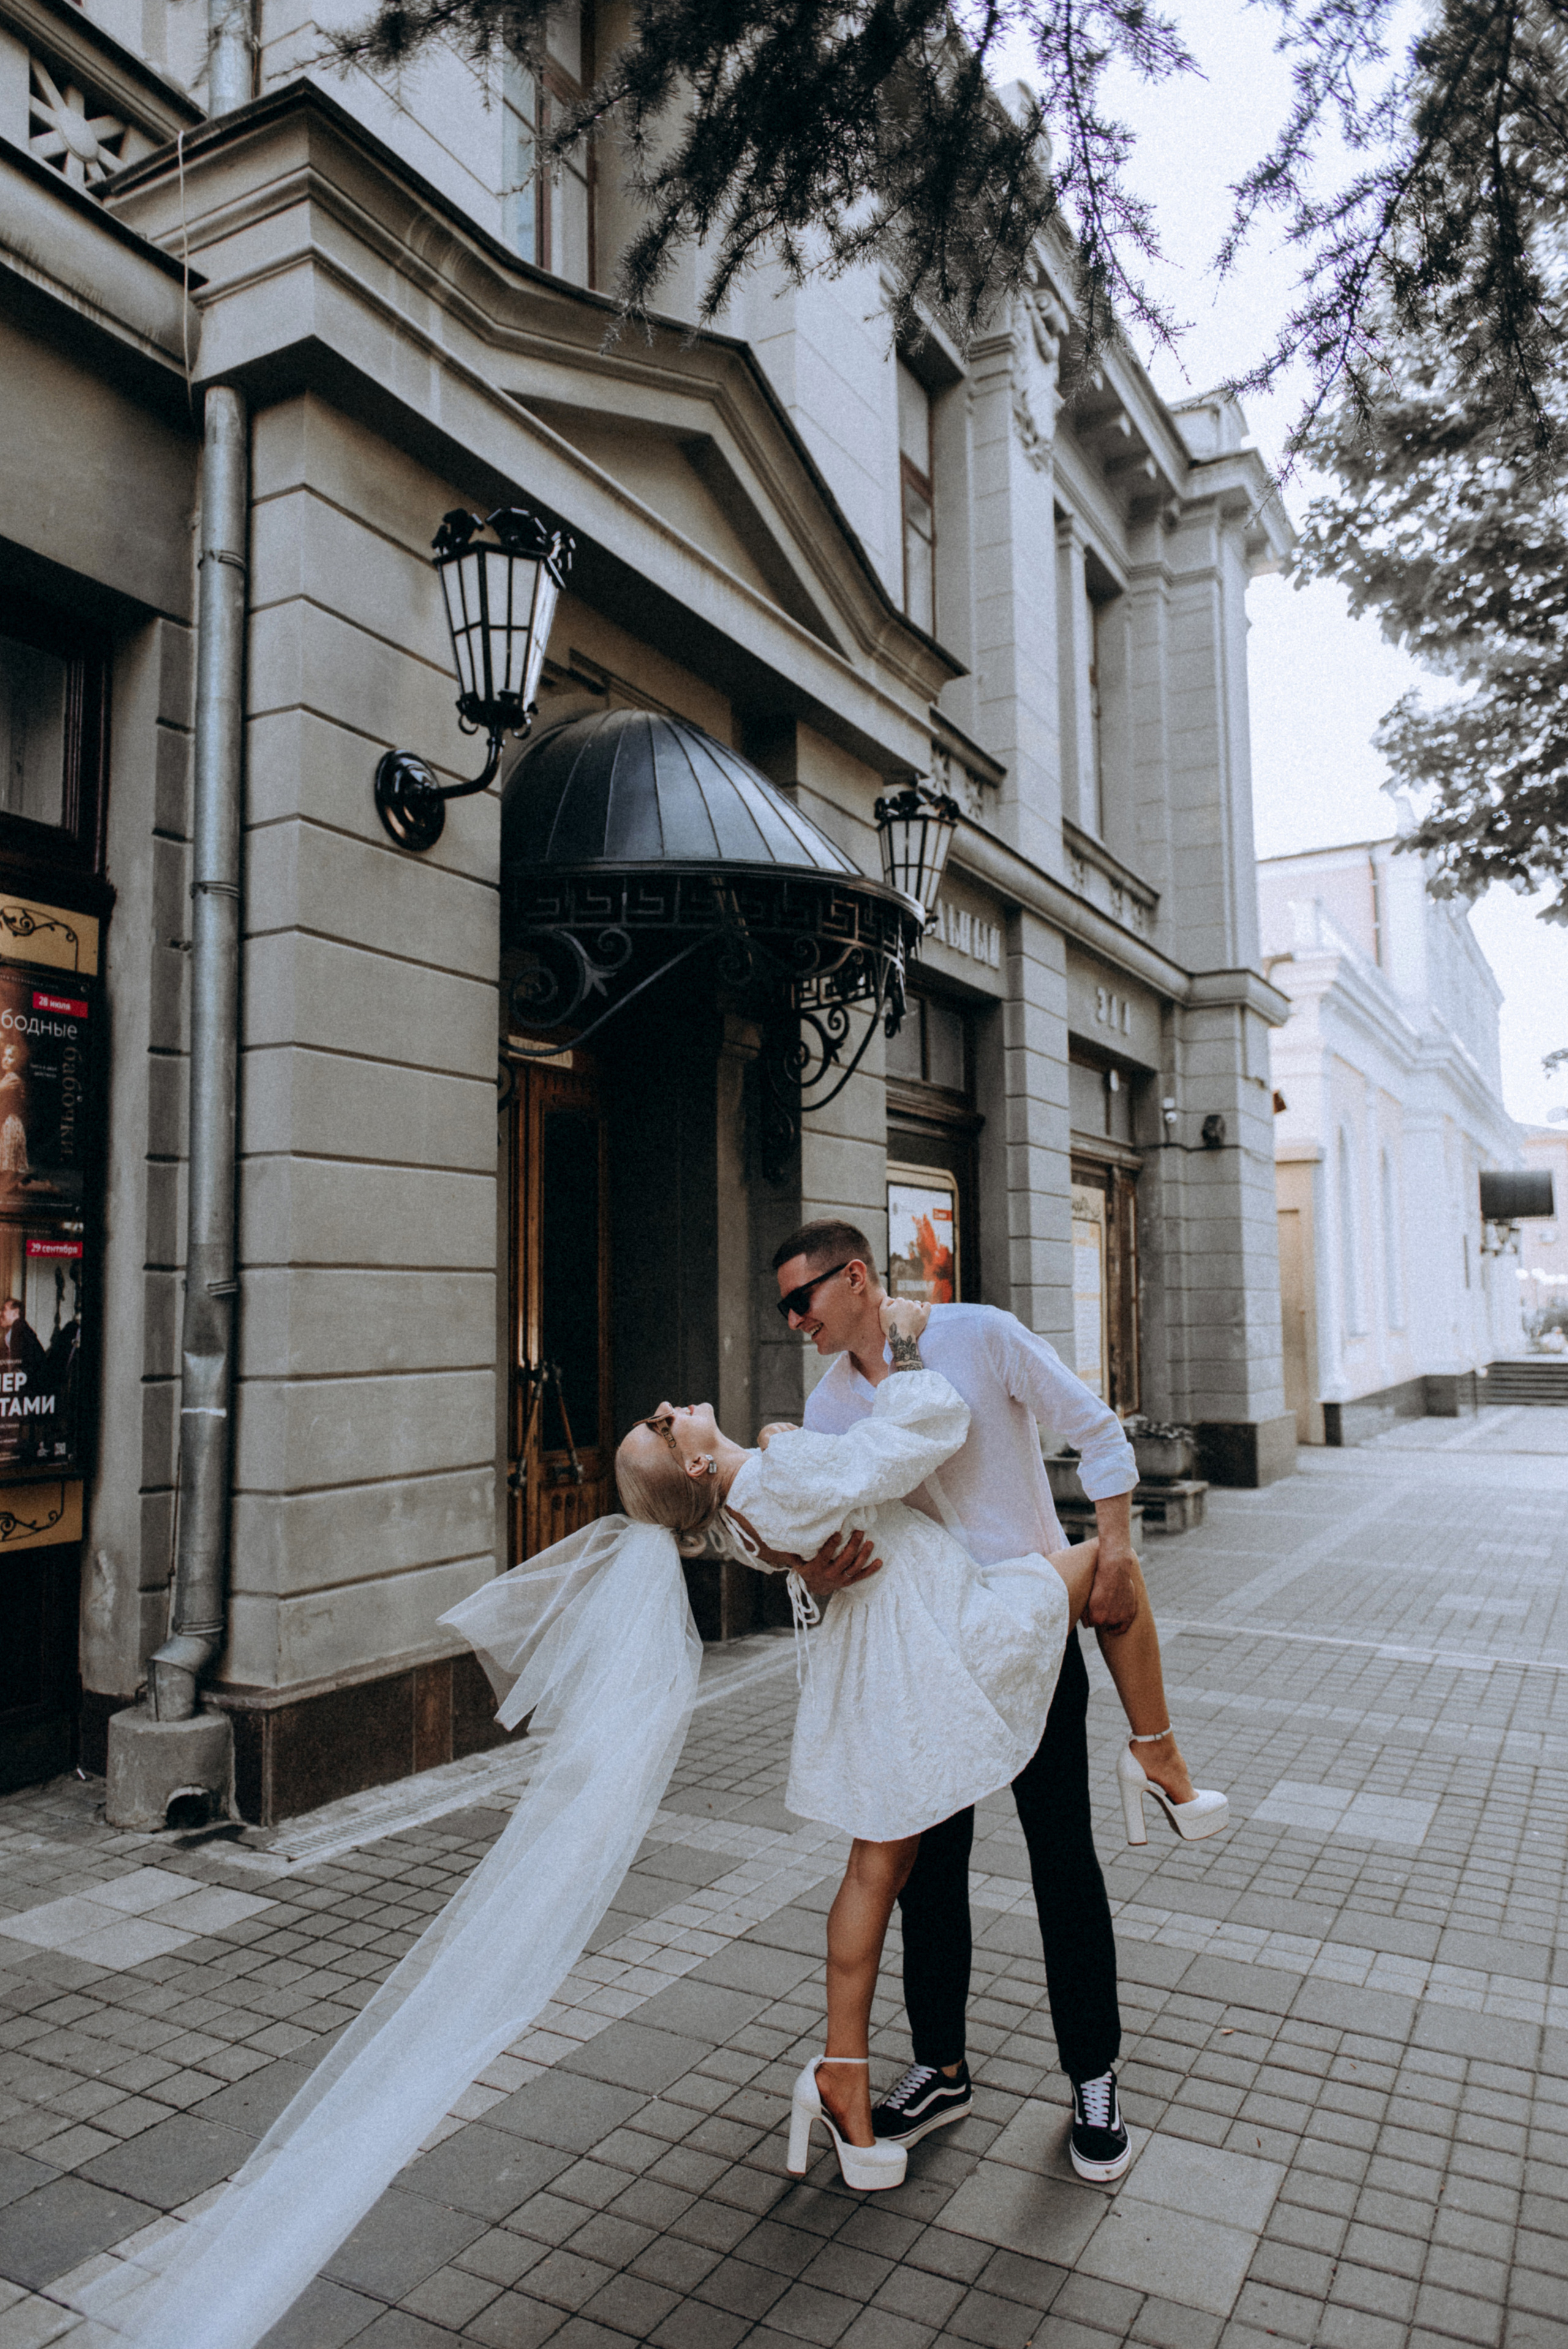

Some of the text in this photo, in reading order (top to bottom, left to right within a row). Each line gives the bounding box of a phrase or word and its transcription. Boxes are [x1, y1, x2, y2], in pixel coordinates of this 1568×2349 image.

[39, 995, 71, 1011] 28 июля
[61, 1047, 83, 1155] бабочки
[31, 1242, 78, 1256] 29 сентября
